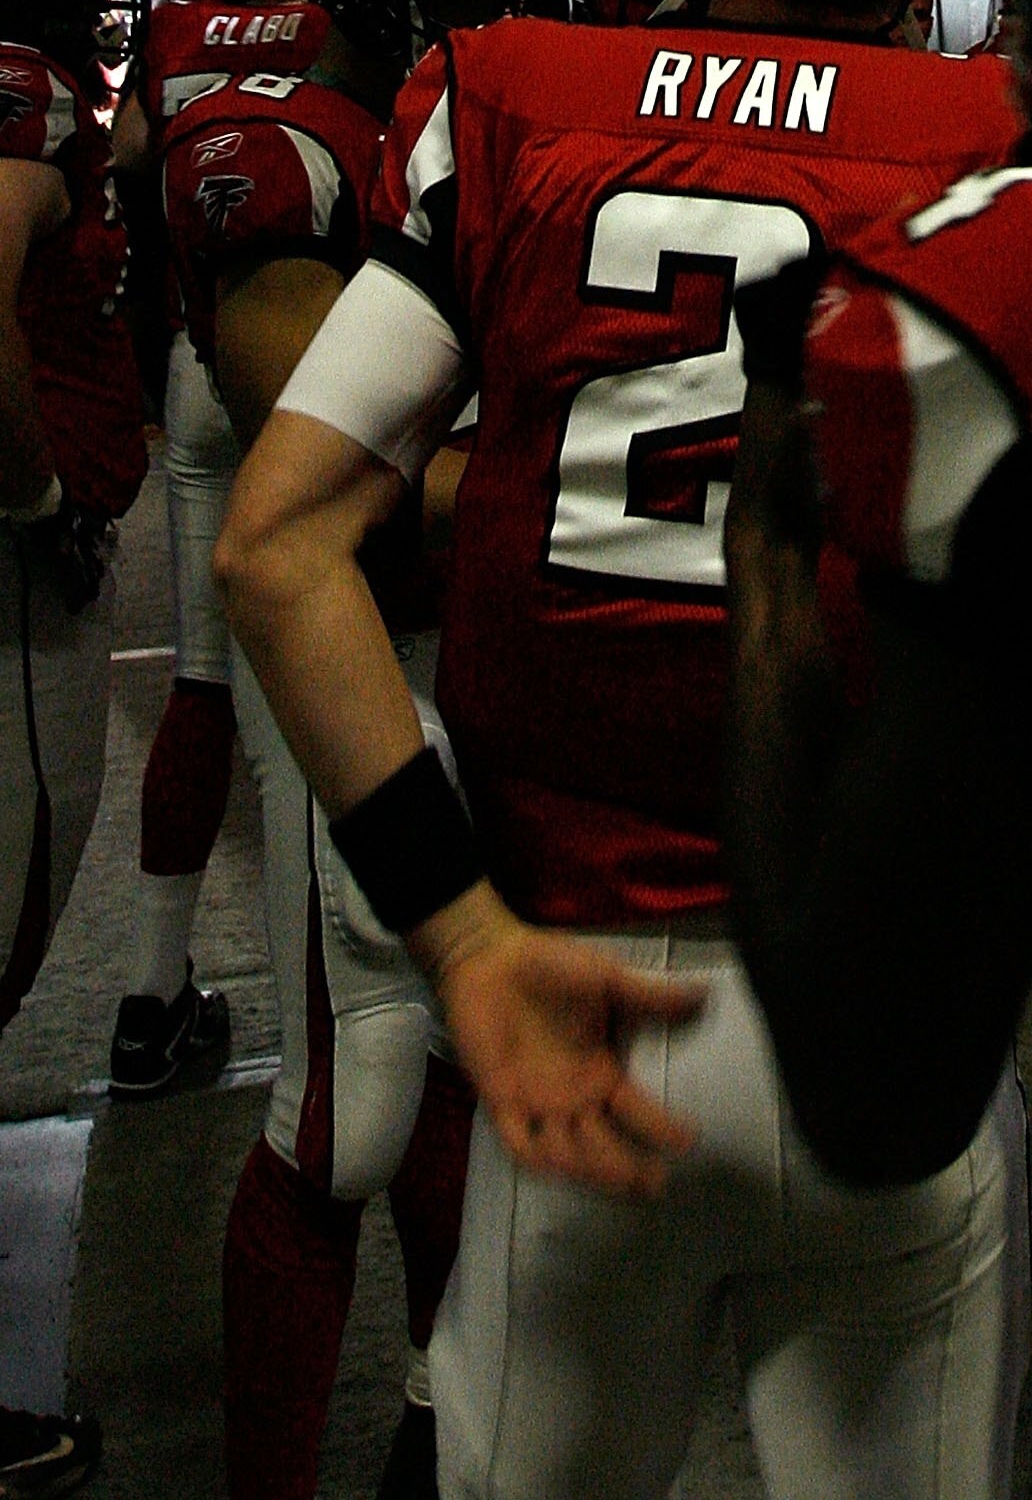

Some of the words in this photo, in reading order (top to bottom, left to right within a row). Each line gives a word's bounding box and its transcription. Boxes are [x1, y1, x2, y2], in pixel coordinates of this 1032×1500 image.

[203, 12, 306, 46] CLABO
[640, 50, 837, 133] RYAN
[548, 191, 811, 587] 2
